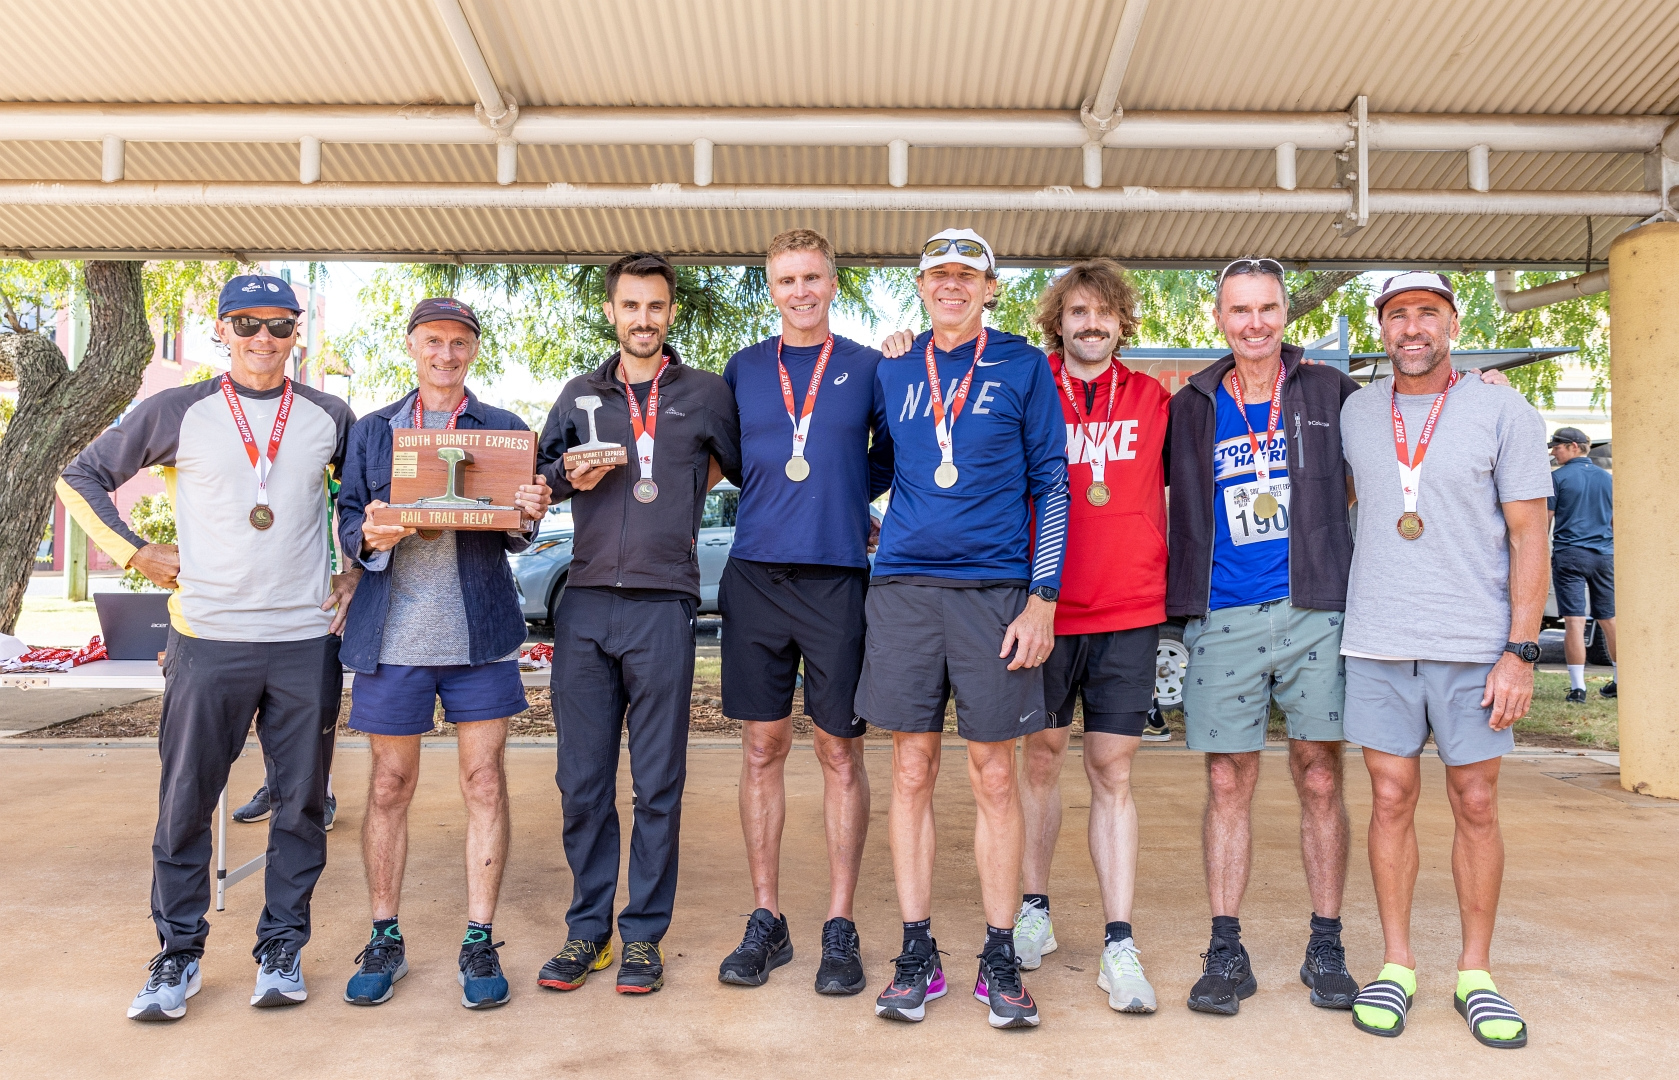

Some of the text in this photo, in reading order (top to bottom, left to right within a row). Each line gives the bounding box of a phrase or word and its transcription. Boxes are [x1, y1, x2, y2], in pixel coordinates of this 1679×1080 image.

[809, 339, 833, 396] CHAMPIONSHIPS
[782, 374, 791, 395] STATE
[958, 376, 971, 399] STATE
[649, 395, 657, 417] STATE
[899, 378, 1002, 423] NIKE
[223, 384, 253, 443] CHAMPIONSHIPS
[1269, 409, 1279, 432] STATE
[273, 420, 285, 442] STATE
[398, 434, 530, 451] SOUTH BURNETT EXPRESS
[1065, 419, 1139, 465] NIKE
[1394, 419, 1405, 443] STATE
[400, 511, 494, 525] RAIL TRAIL RELAY
[1235, 503, 1289, 537] 190
